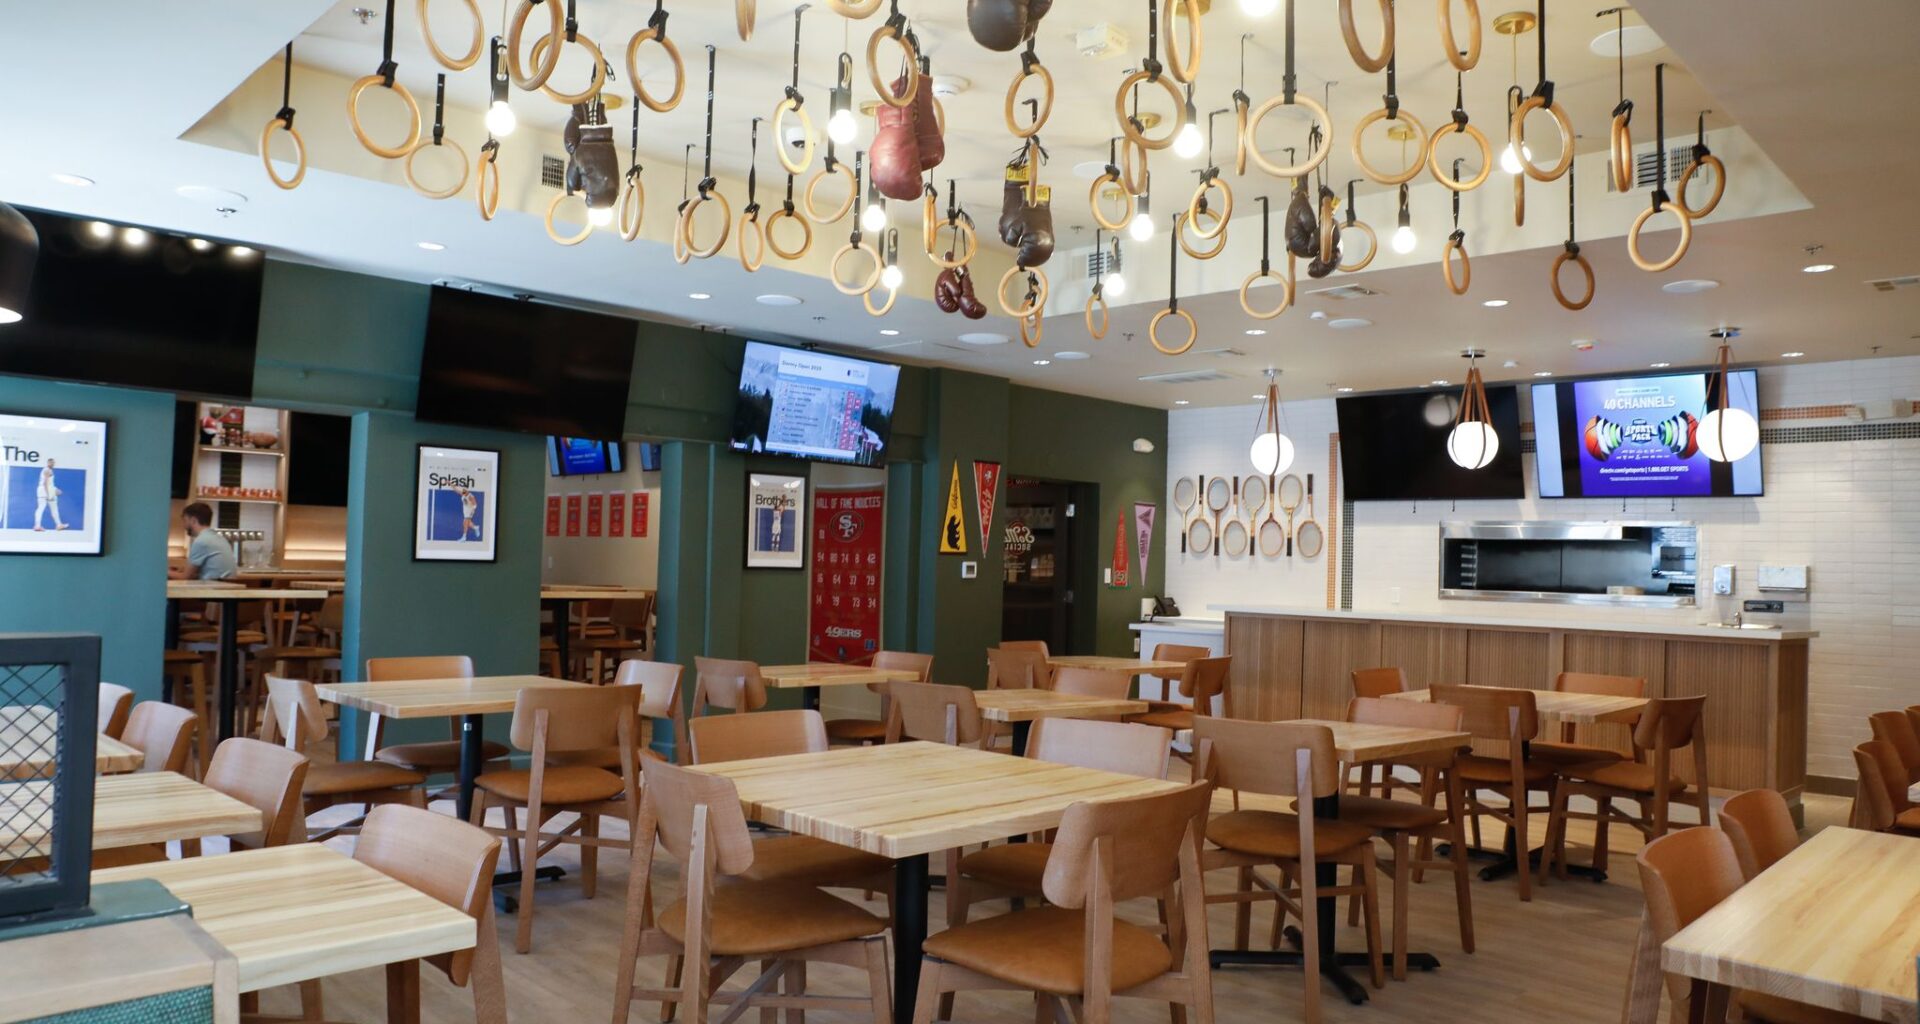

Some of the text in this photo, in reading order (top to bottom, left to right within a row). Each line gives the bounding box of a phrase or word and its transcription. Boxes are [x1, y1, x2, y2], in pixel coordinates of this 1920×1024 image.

[1604, 395, 1676, 410] 40 CHANNELS
[1624, 425, 1657, 436] SPORTS
[3, 445, 40, 463] The
[429, 472, 475, 489] Splash
[755, 493, 796, 507] Brothrs
